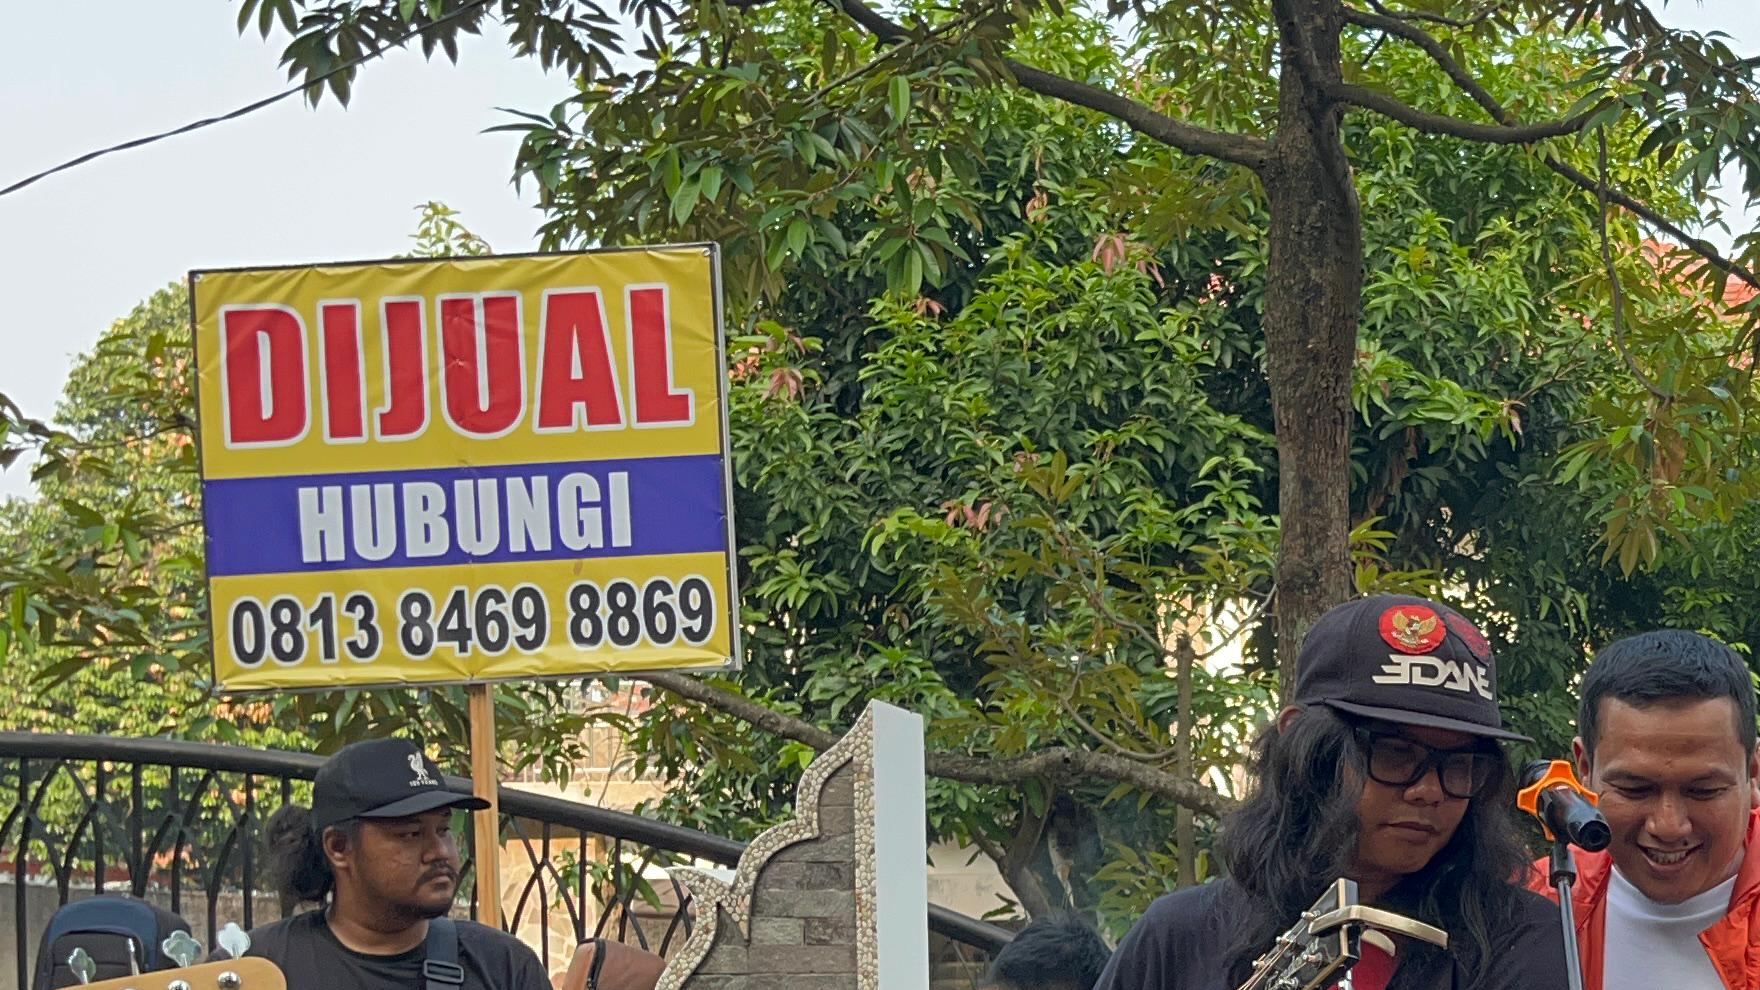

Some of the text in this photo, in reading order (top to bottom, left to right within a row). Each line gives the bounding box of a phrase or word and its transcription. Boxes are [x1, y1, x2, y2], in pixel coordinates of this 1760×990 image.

[219, 283, 695, 449] DIJUAL
[297, 471, 633, 564] HUBUNGI
[231, 575, 715, 666] 0813 8469 8869
